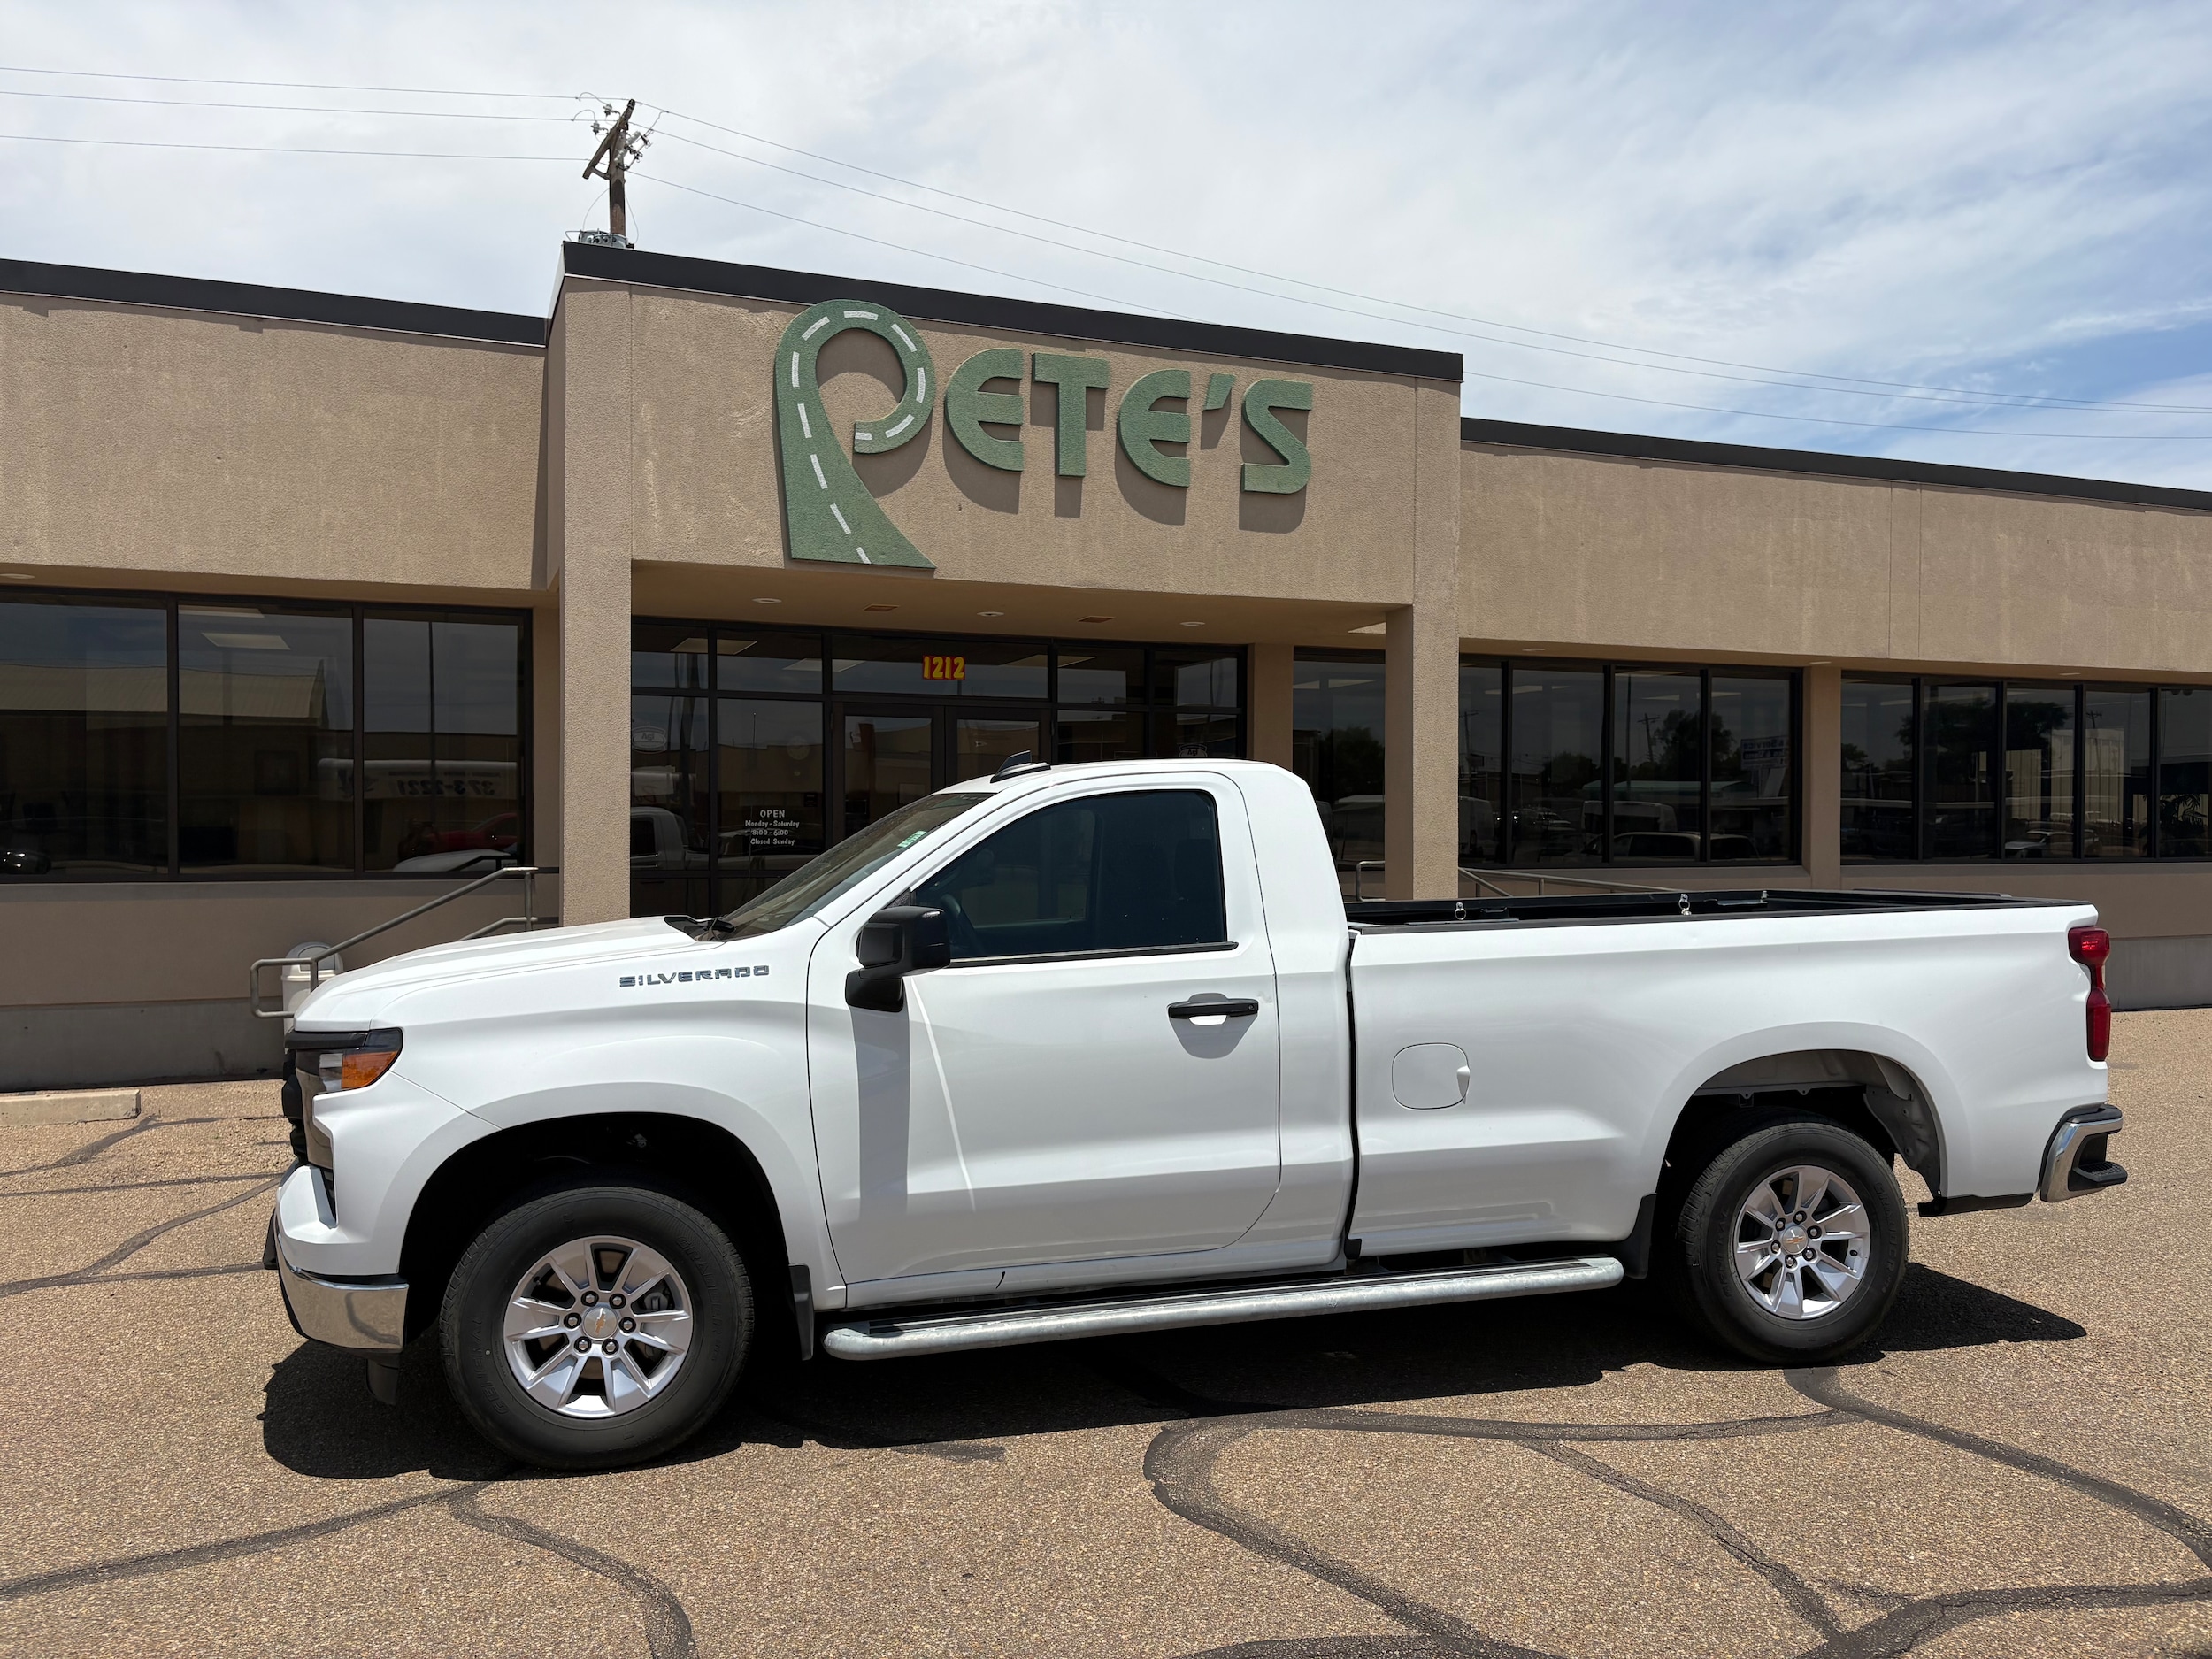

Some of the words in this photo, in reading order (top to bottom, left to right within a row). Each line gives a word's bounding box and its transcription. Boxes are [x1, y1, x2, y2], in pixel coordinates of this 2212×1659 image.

[774, 298, 1314, 570] PETE'S
[923, 656, 965, 680] 1212
[759, 809, 786, 818] OPEN
[745, 819, 768, 829] Monday
[772, 819, 800, 829] Saturday
[772, 838, 795, 847] Sunday
[619, 964, 770, 988] SILVERADO
